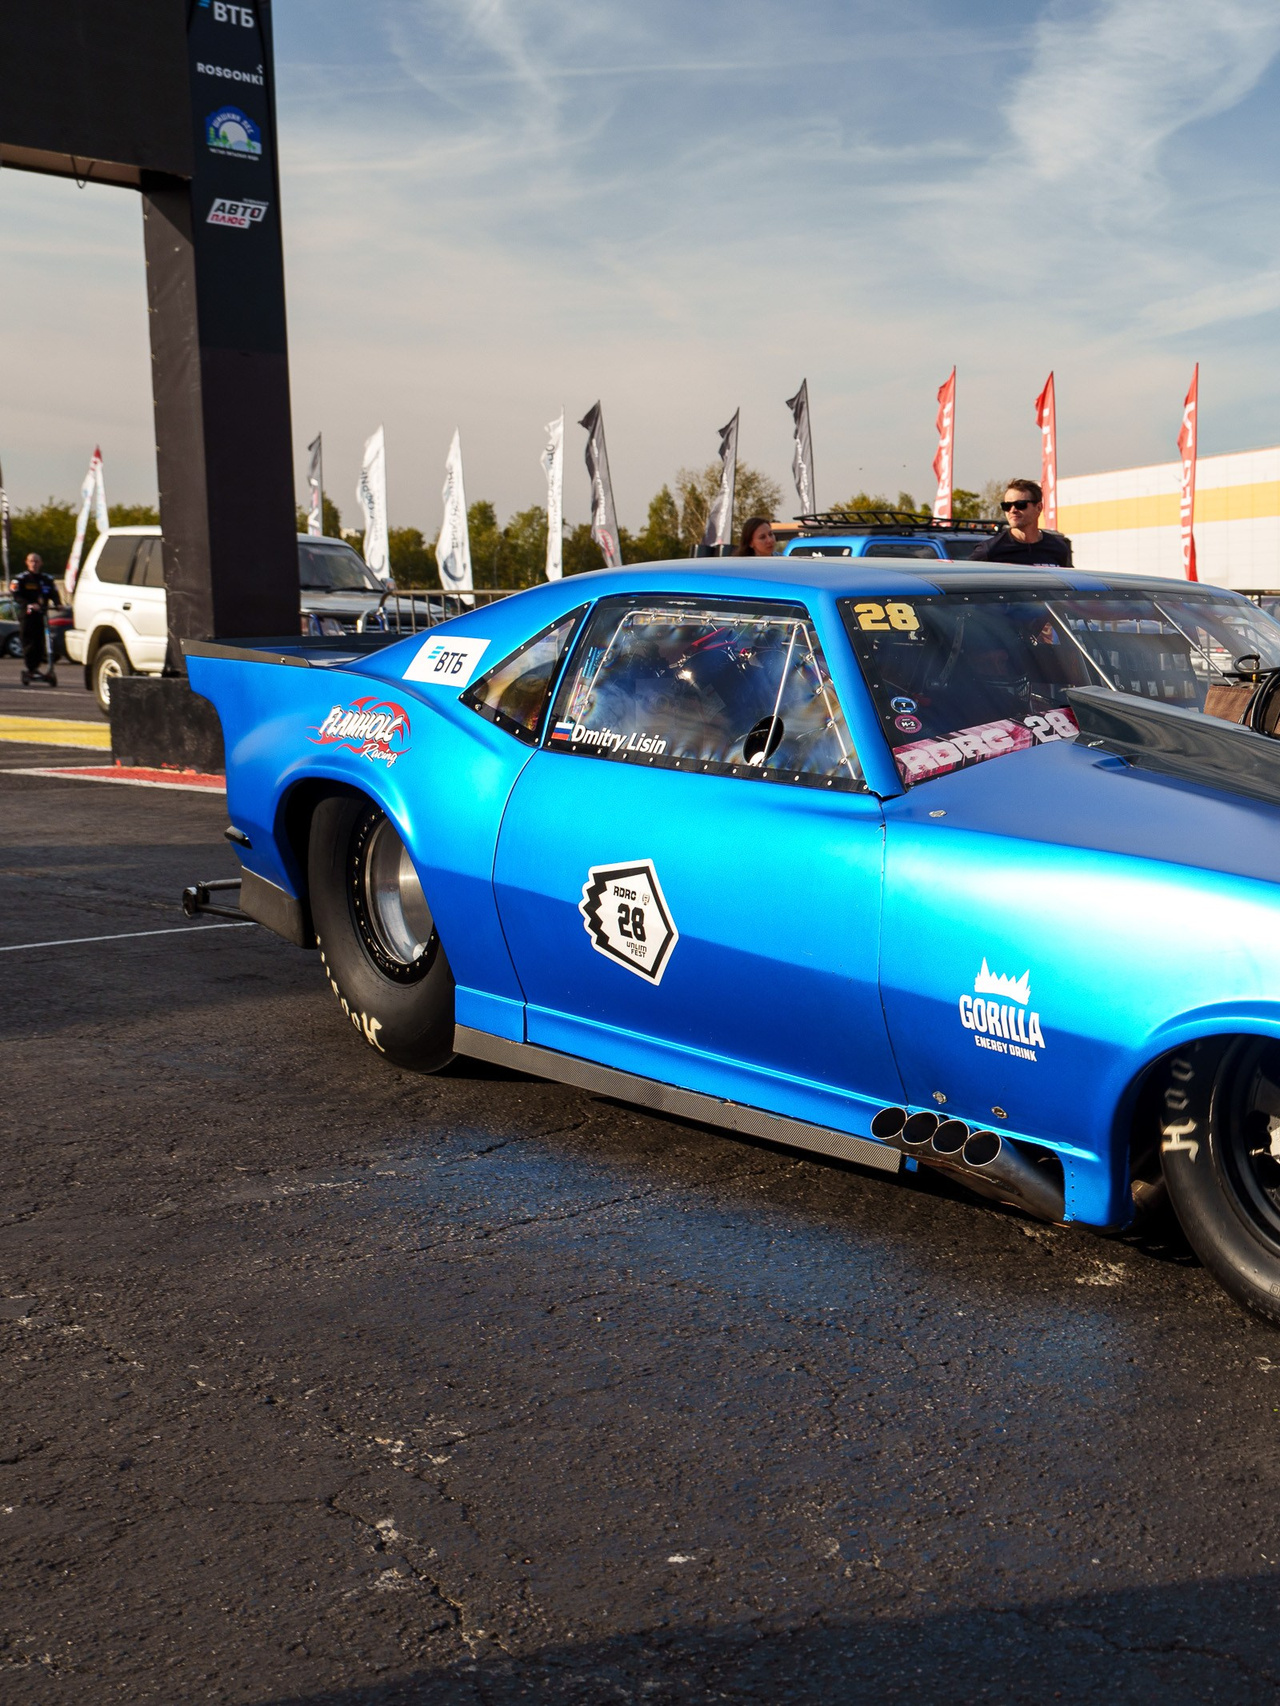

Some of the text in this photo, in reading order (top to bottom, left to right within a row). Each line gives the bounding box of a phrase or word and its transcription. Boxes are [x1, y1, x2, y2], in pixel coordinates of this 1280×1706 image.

[213, 1, 254, 28] ВТБ
[196, 62, 264, 86] ROSGONKI
[210, 213, 247, 226] ПЛЮС
[214, 202, 262, 219] АВТО
[853, 602, 920, 631] 28
[433, 651, 468, 674] ВТБ
[571, 724, 667, 754] Dmitry Lisin
[1023, 711, 1080, 743] 28
[360, 743, 399, 768] Racing
[895, 728, 1015, 775] RDRC
[613, 885, 637, 901] RDRC
[617, 903, 647, 942] 28
[959, 994, 1046, 1049] GORILLA
[974, 1035, 1037, 1062] ENERGY DRINK
